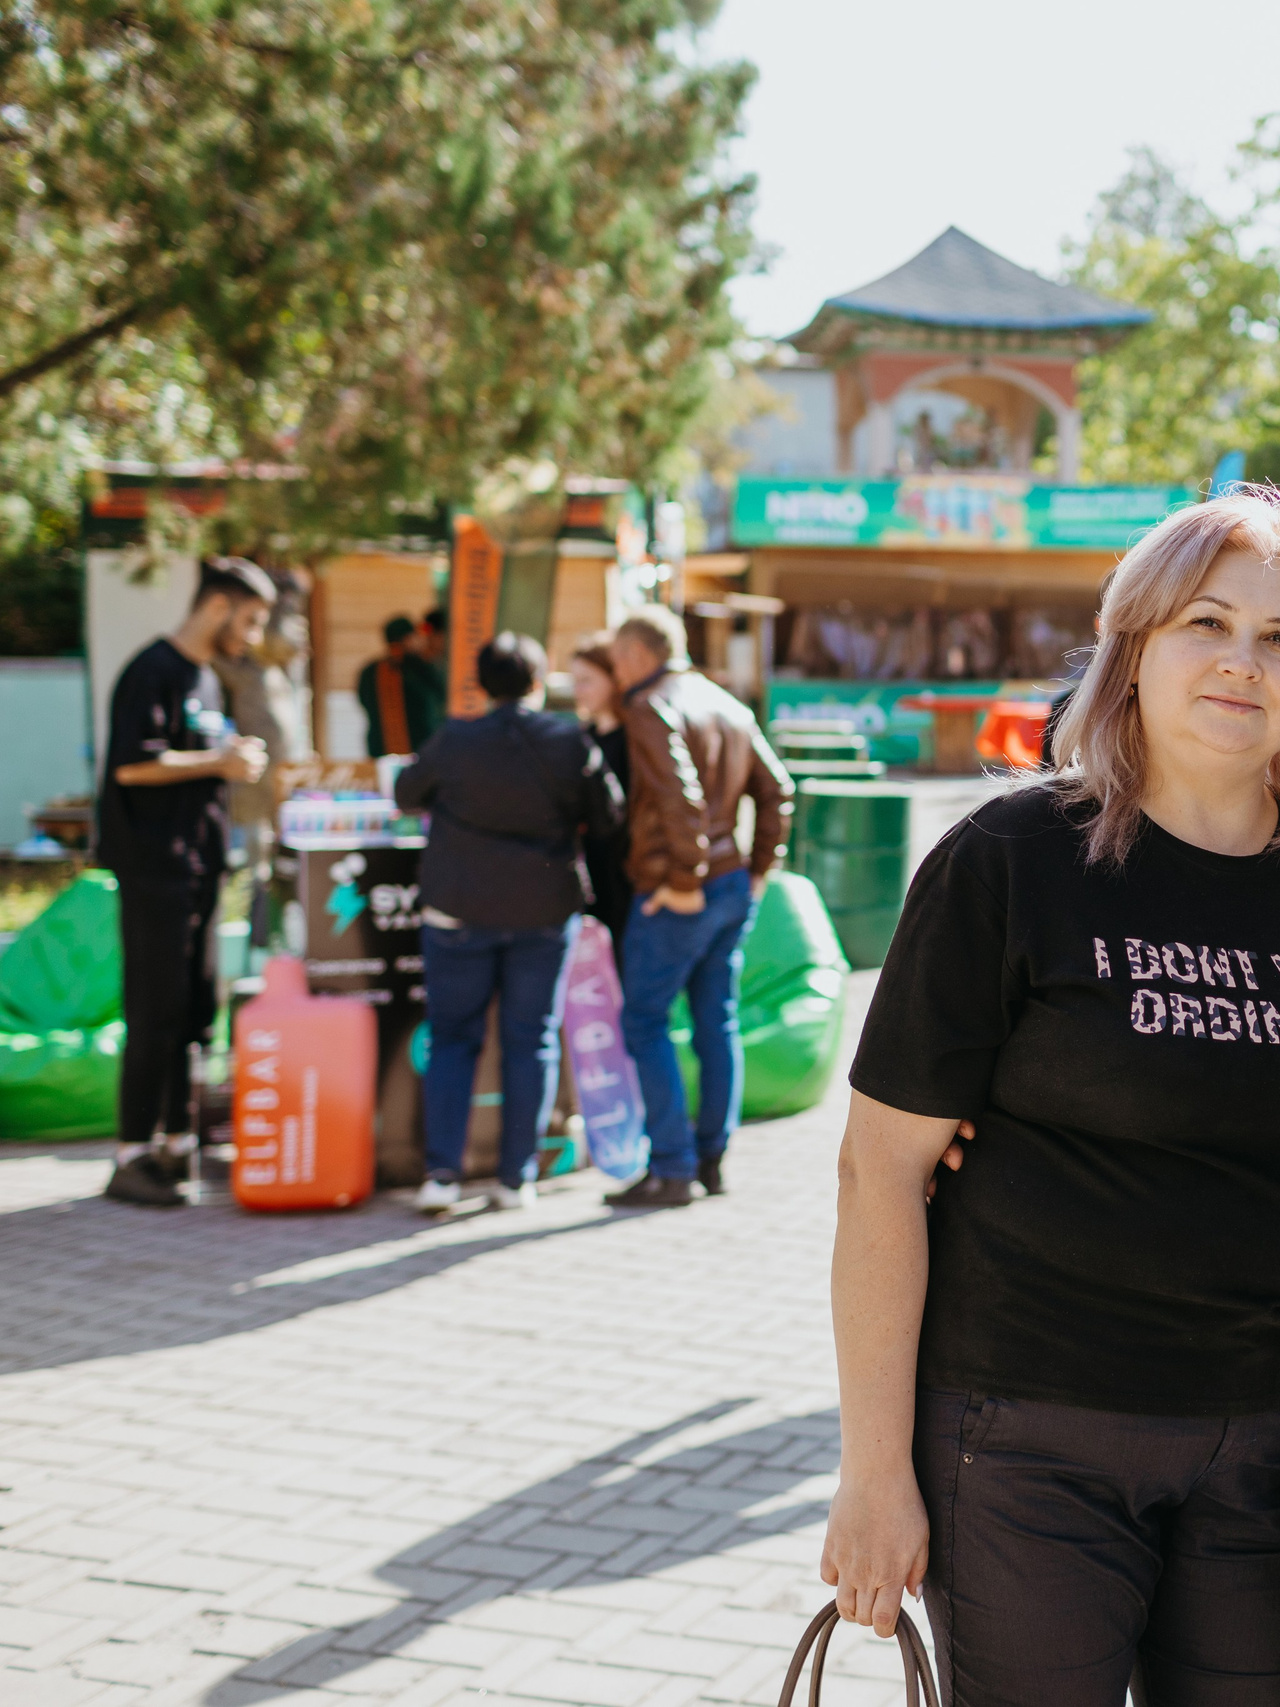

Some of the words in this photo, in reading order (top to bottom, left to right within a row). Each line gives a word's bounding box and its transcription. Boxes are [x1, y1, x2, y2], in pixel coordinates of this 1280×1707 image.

[1092, 937, 1111, 978] I
[1125, 938, 1259, 990] DONT
[241, 1028, 281, 1186] ELFBAR
